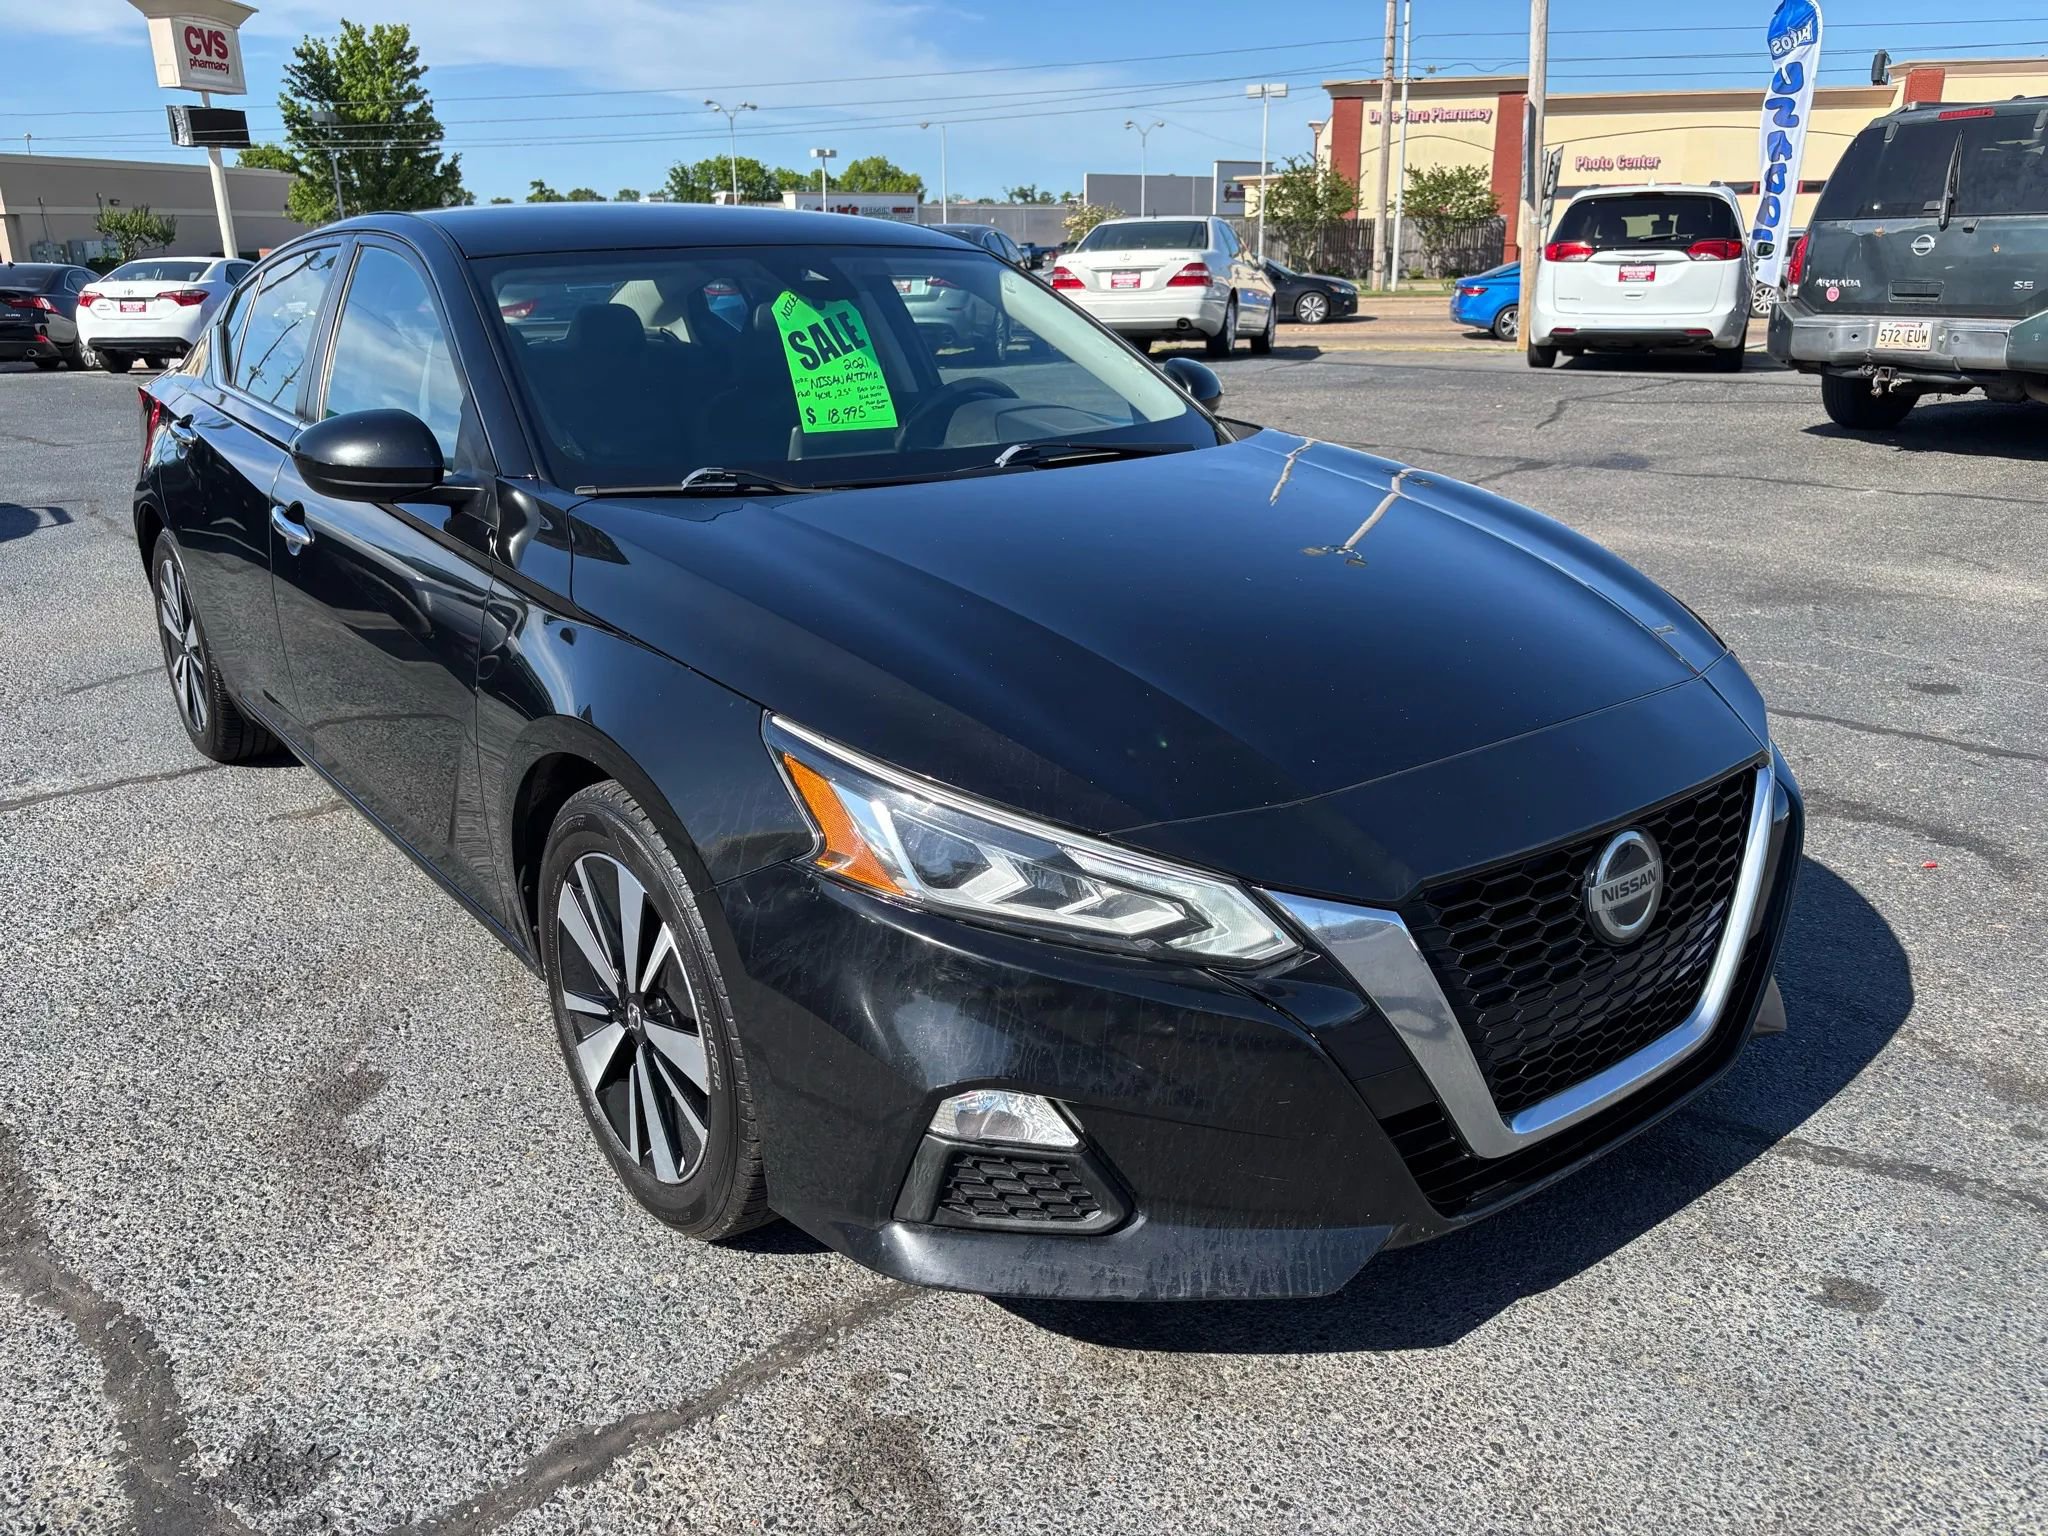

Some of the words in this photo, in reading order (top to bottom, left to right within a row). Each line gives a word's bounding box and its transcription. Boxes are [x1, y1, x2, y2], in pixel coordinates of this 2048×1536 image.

[184, 26, 229, 60] CVS
[190, 56, 230, 74] pharmacy
[1431, 107, 1492, 124] Pharmacy
[1576, 156, 1613, 171] Photo
[1616, 155, 1661, 170] Center
[1815, 277, 1861, 288] ARMADA
[2013, 280, 2034, 290] SE
[788, 311, 867, 370] SALE
[1880, 329, 1901, 343] 572
[1907, 329, 1928, 343] EUW
[843, 357, 869, 370] 2021
[810, 373, 844, 389] NISSAN
[846, 372, 878, 384] ALTIMA
[806, 405, 816, 425] $
[828, 406, 867, 424] 18,995
[1601, 867, 1656, 904] NISSAN
